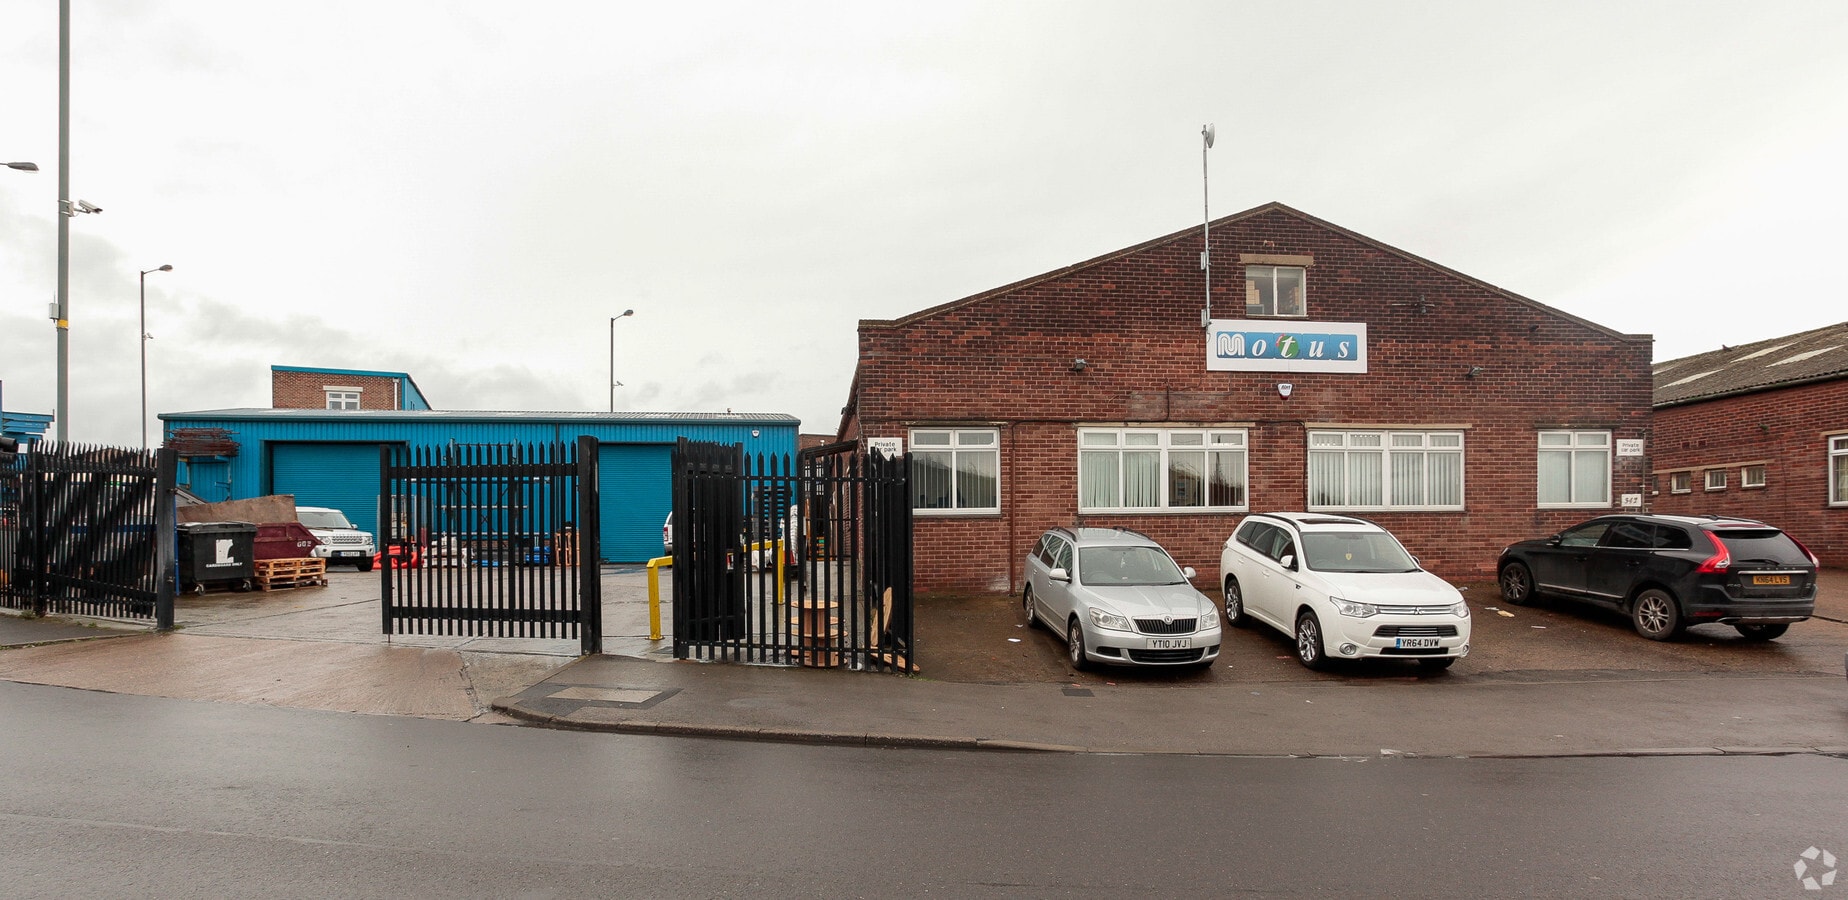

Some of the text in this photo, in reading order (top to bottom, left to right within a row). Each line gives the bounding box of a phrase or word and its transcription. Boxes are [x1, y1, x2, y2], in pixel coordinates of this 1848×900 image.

[1217, 333, 1350, 358] Motus
[1152, 640, 1187, 648] YT10 JVJ
[1402, 639, 1422, 647] YR64
